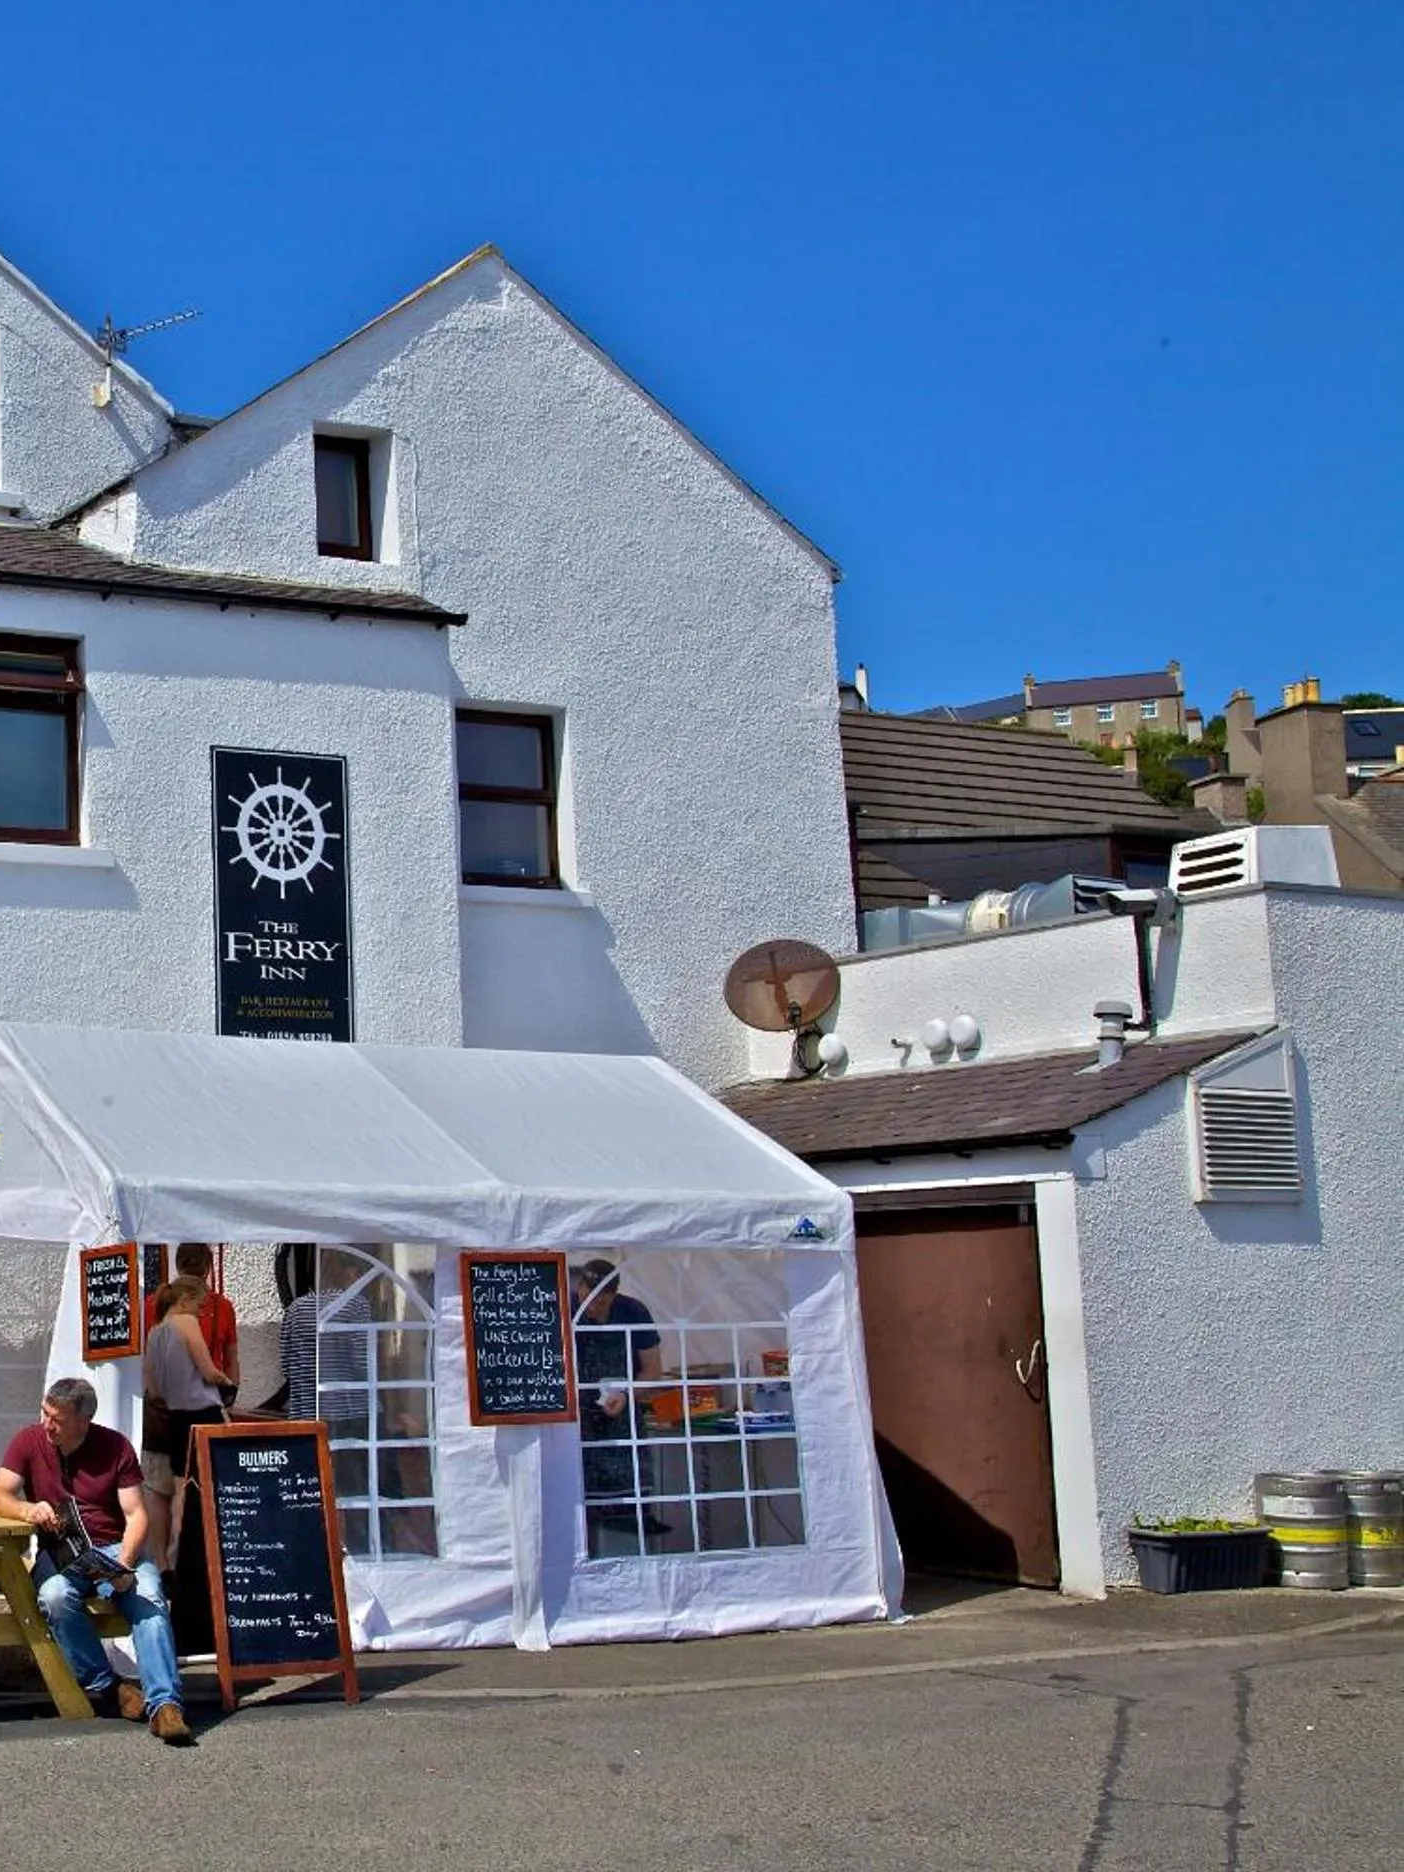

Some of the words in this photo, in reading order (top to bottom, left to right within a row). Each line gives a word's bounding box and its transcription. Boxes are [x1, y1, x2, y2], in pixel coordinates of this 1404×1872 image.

[258, 920, 298, 934] THE
[223, 931, 342, 962] FERRY
[260, 964, 307, 981] INN
[471, 1266, 489, 1278] The
[493, 1264, 517, 1287] Ferry
[506, 1285, 529, 1303] Bar
[532, 1285, 557, 1311] Open
[477, 1346, 539, 1369] Mackerel
[239, 1450, 289, 1467] BULMERS
